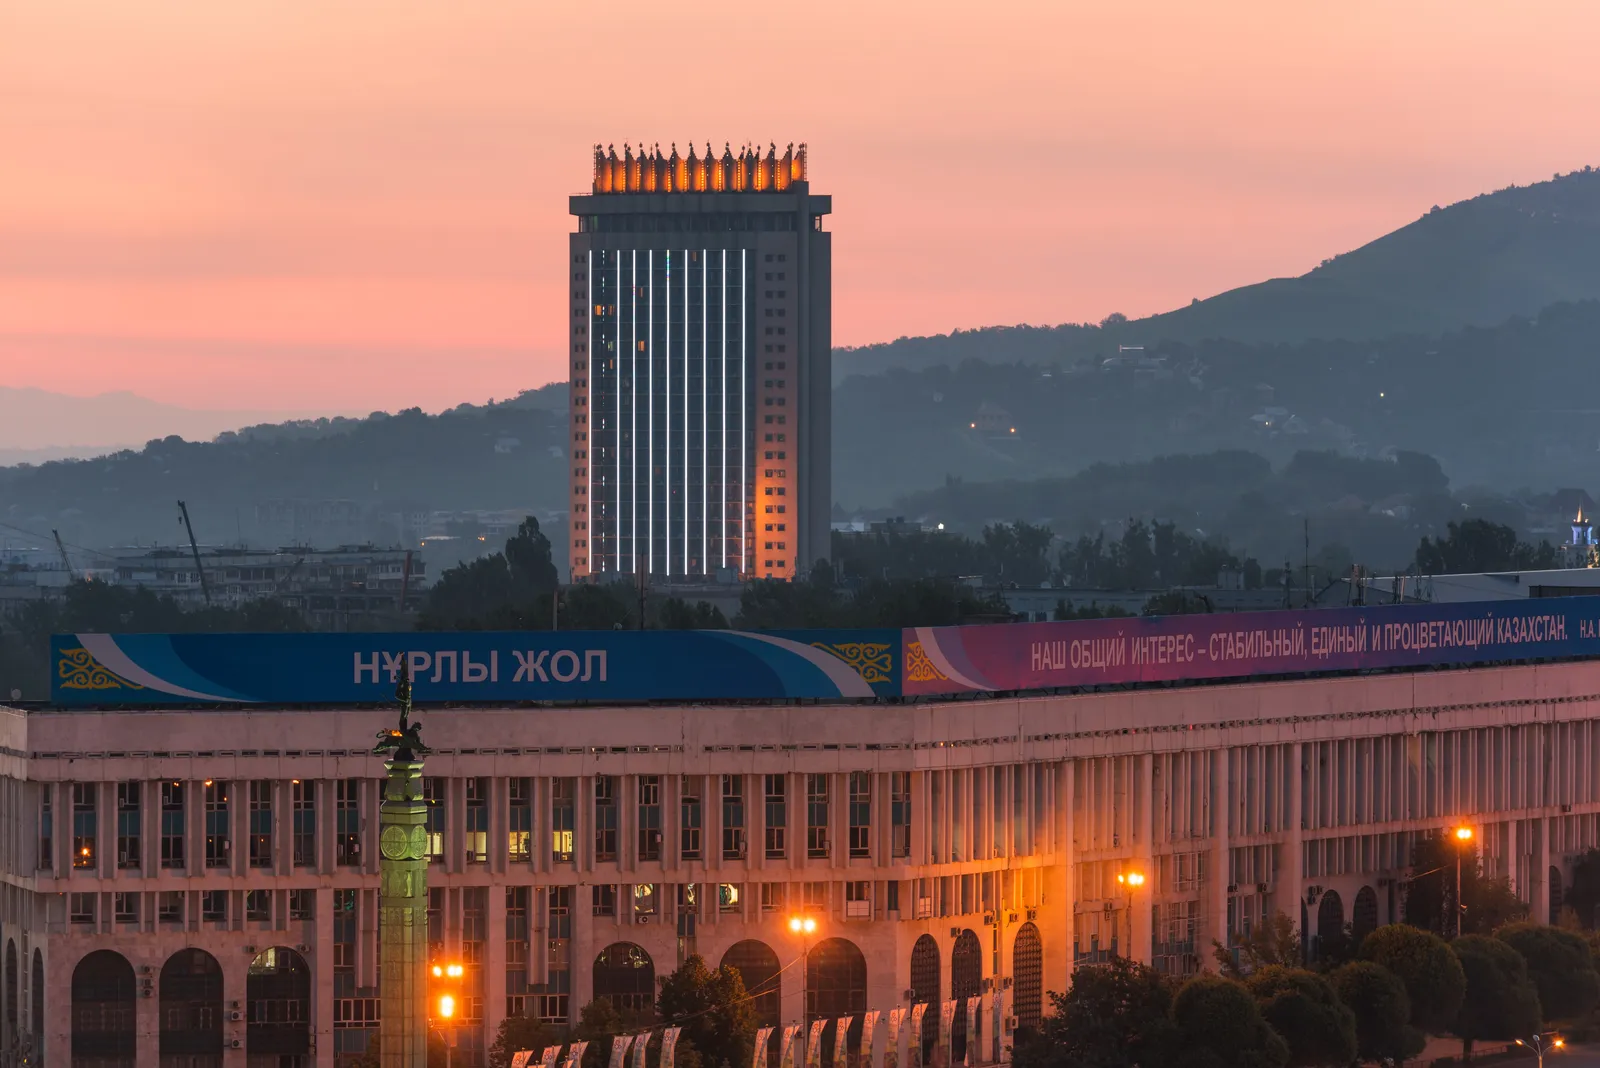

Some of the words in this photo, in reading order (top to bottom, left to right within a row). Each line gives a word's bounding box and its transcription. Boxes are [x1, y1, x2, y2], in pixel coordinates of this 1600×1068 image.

[1032, 641, 1066, 671] НАШ
[1070, 630, 1126, 672] ОБЩИЙ
[1131, 634, 1195, 665] ИНТЕРЕС
[1209, 621, 1308, 661] СТАБИЛЬНЫЙ,
[1311, 618, 1367, 659] ЕДИНЫЙ
[1372, 625, 1381, 651] И
[1384, 612, 1494, 653] ПРОЦВЕТАЮЩИЙ
[1497, 614, 1568, 642] КАЗАХСТАН.
[353, 650, 499, 683] НҰРЛЫ
[512, 649, 608, 682] ЖОЛ
